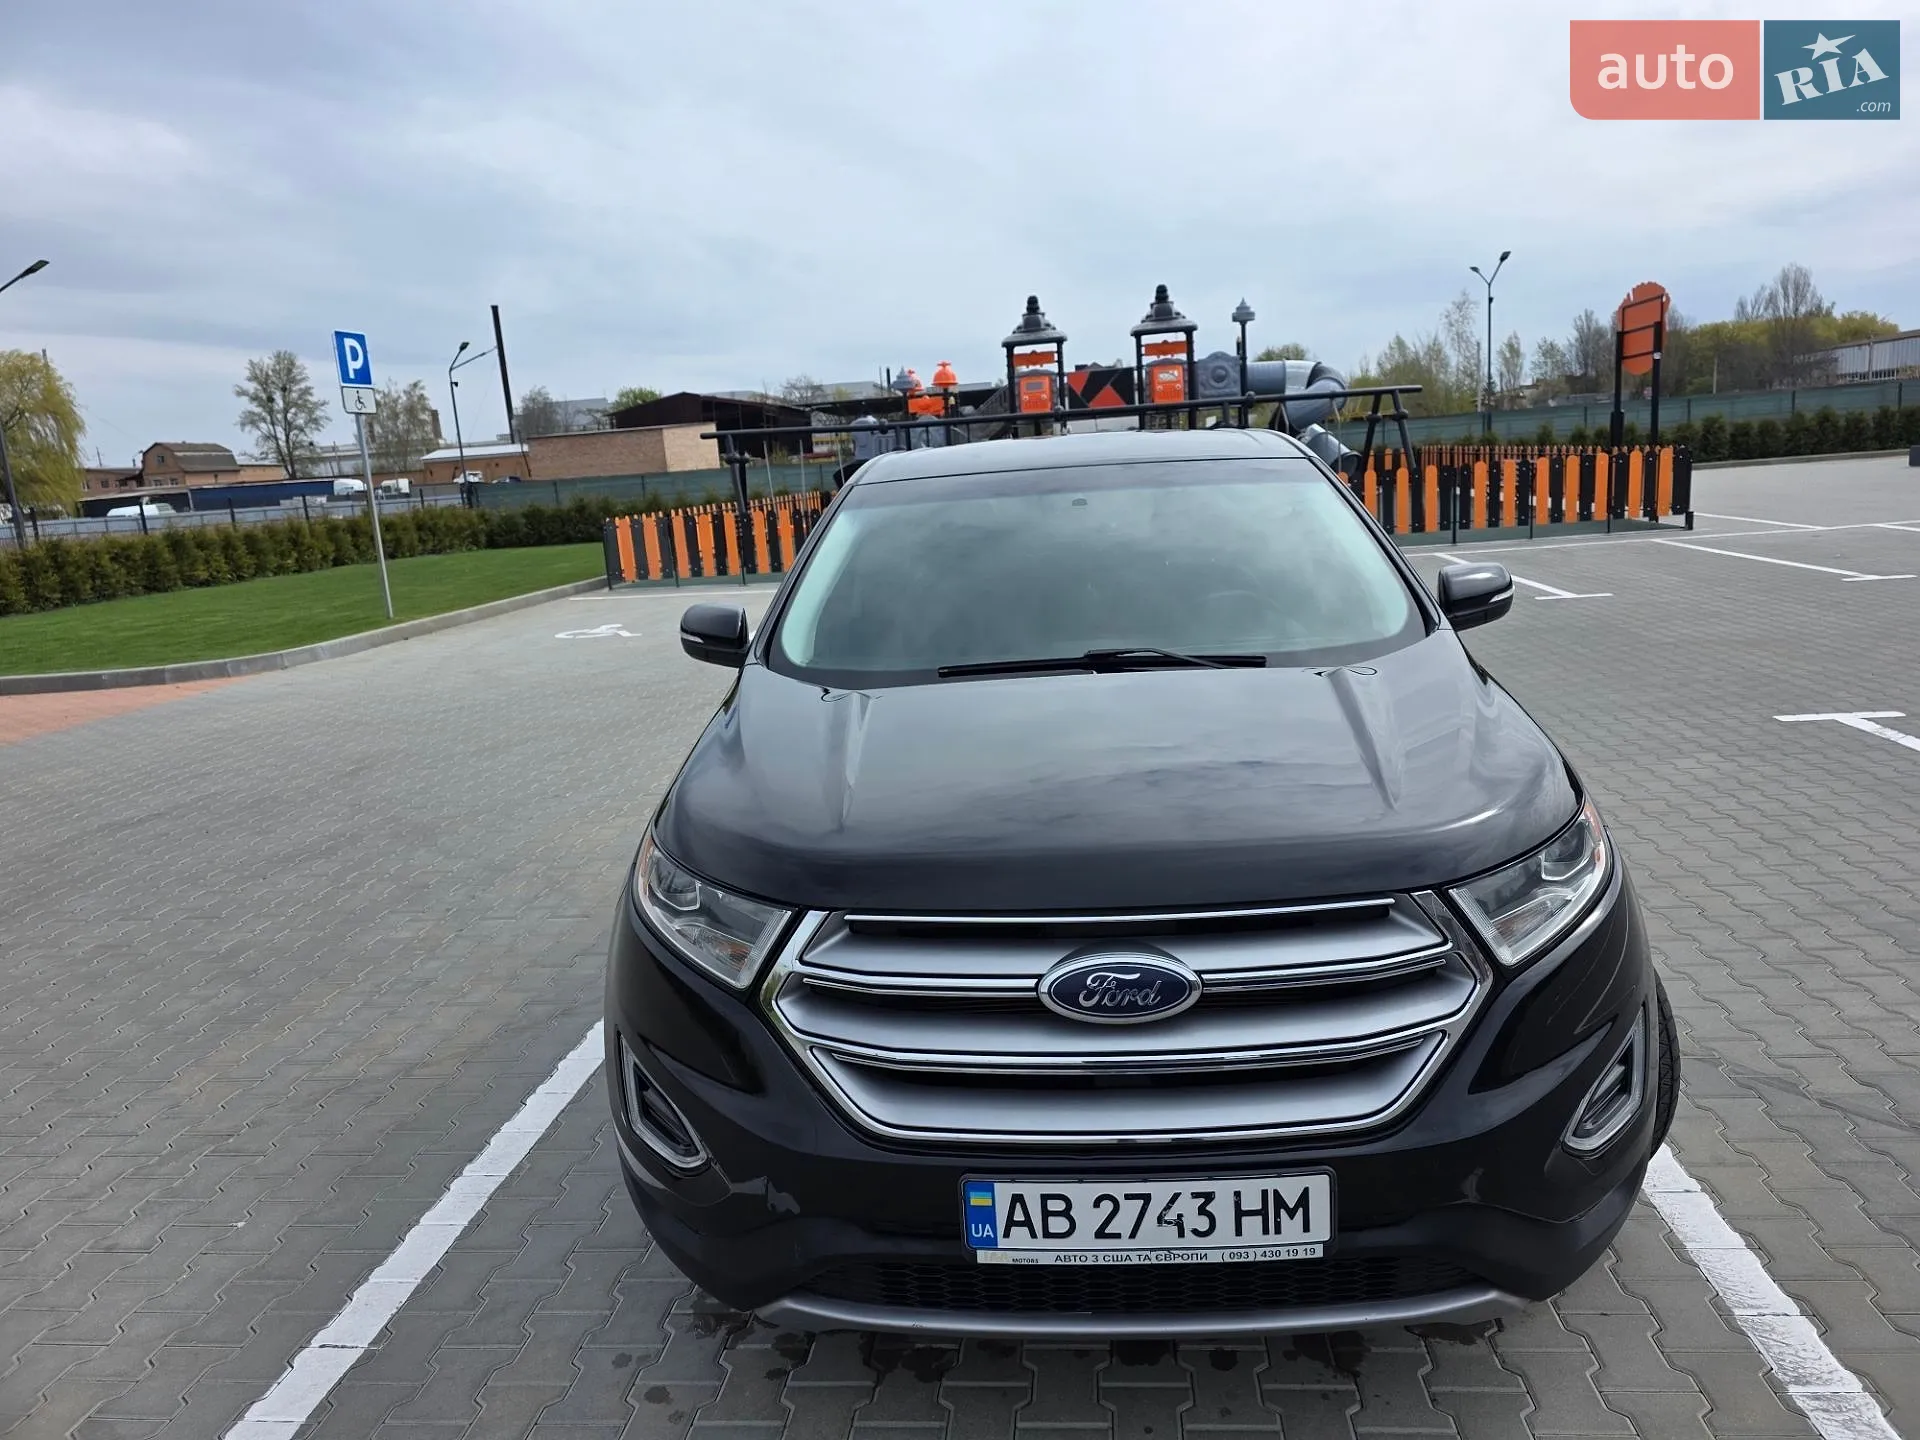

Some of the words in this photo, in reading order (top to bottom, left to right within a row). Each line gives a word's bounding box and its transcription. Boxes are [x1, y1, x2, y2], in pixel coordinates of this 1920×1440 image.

[343, 337, 364, 379] P
[1078, 971, 1163, 1008] Ford
[971, 1223, 994, 1238] UA
[1002, 1192, 1077, 1240] AB
[1092, 1191, 1217, 1240] 2743
[1233, 1186, 1311, 1237] HM
[1054, 1254, 1088, 1263] АВТО
[1102, 1253, 1133, 1263] США
[1136, 1253, 1152, 1263] ТА
[1155, 1252, 1208, 1262] ЄВРОПИ
[1260, 1249, 1281, 1259] 430
[1286, 1248, 1299, 1257] 19
[1303, 1247, 1316, 1256] 19
